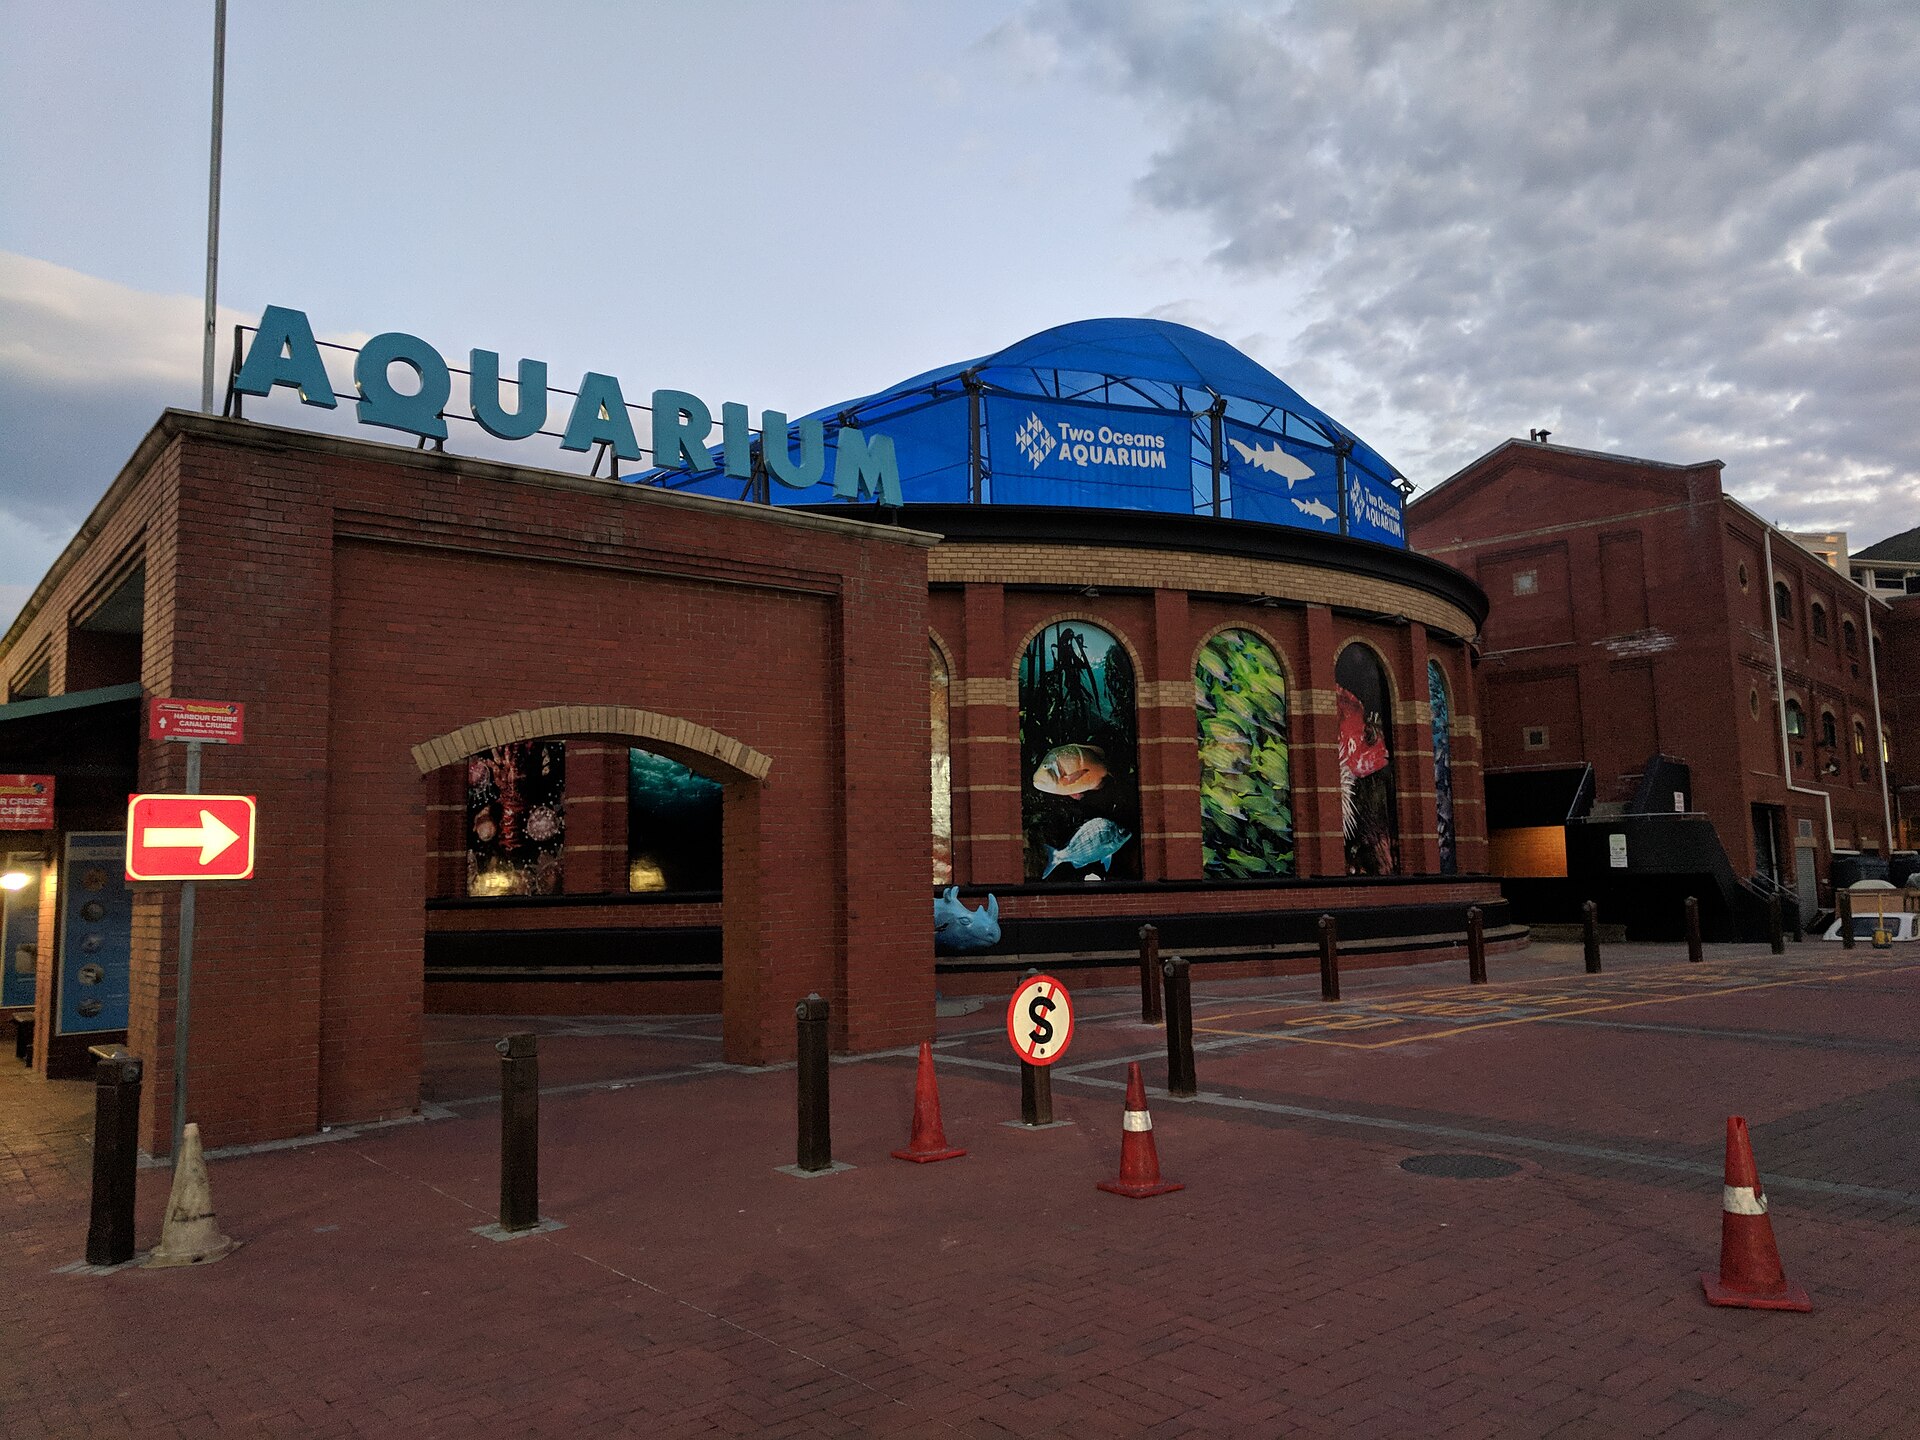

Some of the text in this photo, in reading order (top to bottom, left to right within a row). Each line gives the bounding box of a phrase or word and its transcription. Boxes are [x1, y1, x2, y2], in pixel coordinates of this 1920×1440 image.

[234, 304, 904, 509] AQUARIUM
[1058, 422, 1165, 449] Two Oceans
[1058, 442, 1167, 469] AQUARIUM
[1364, 486, 1400, 521] Two Oceans
[1365, 505, 1401, 538] AQUARIUM
[173, 713, 238, 723] HARBOUR CRUISE
[179, 720, 204, 728] CANAL
[1028, 996, 1056, 1044] S
